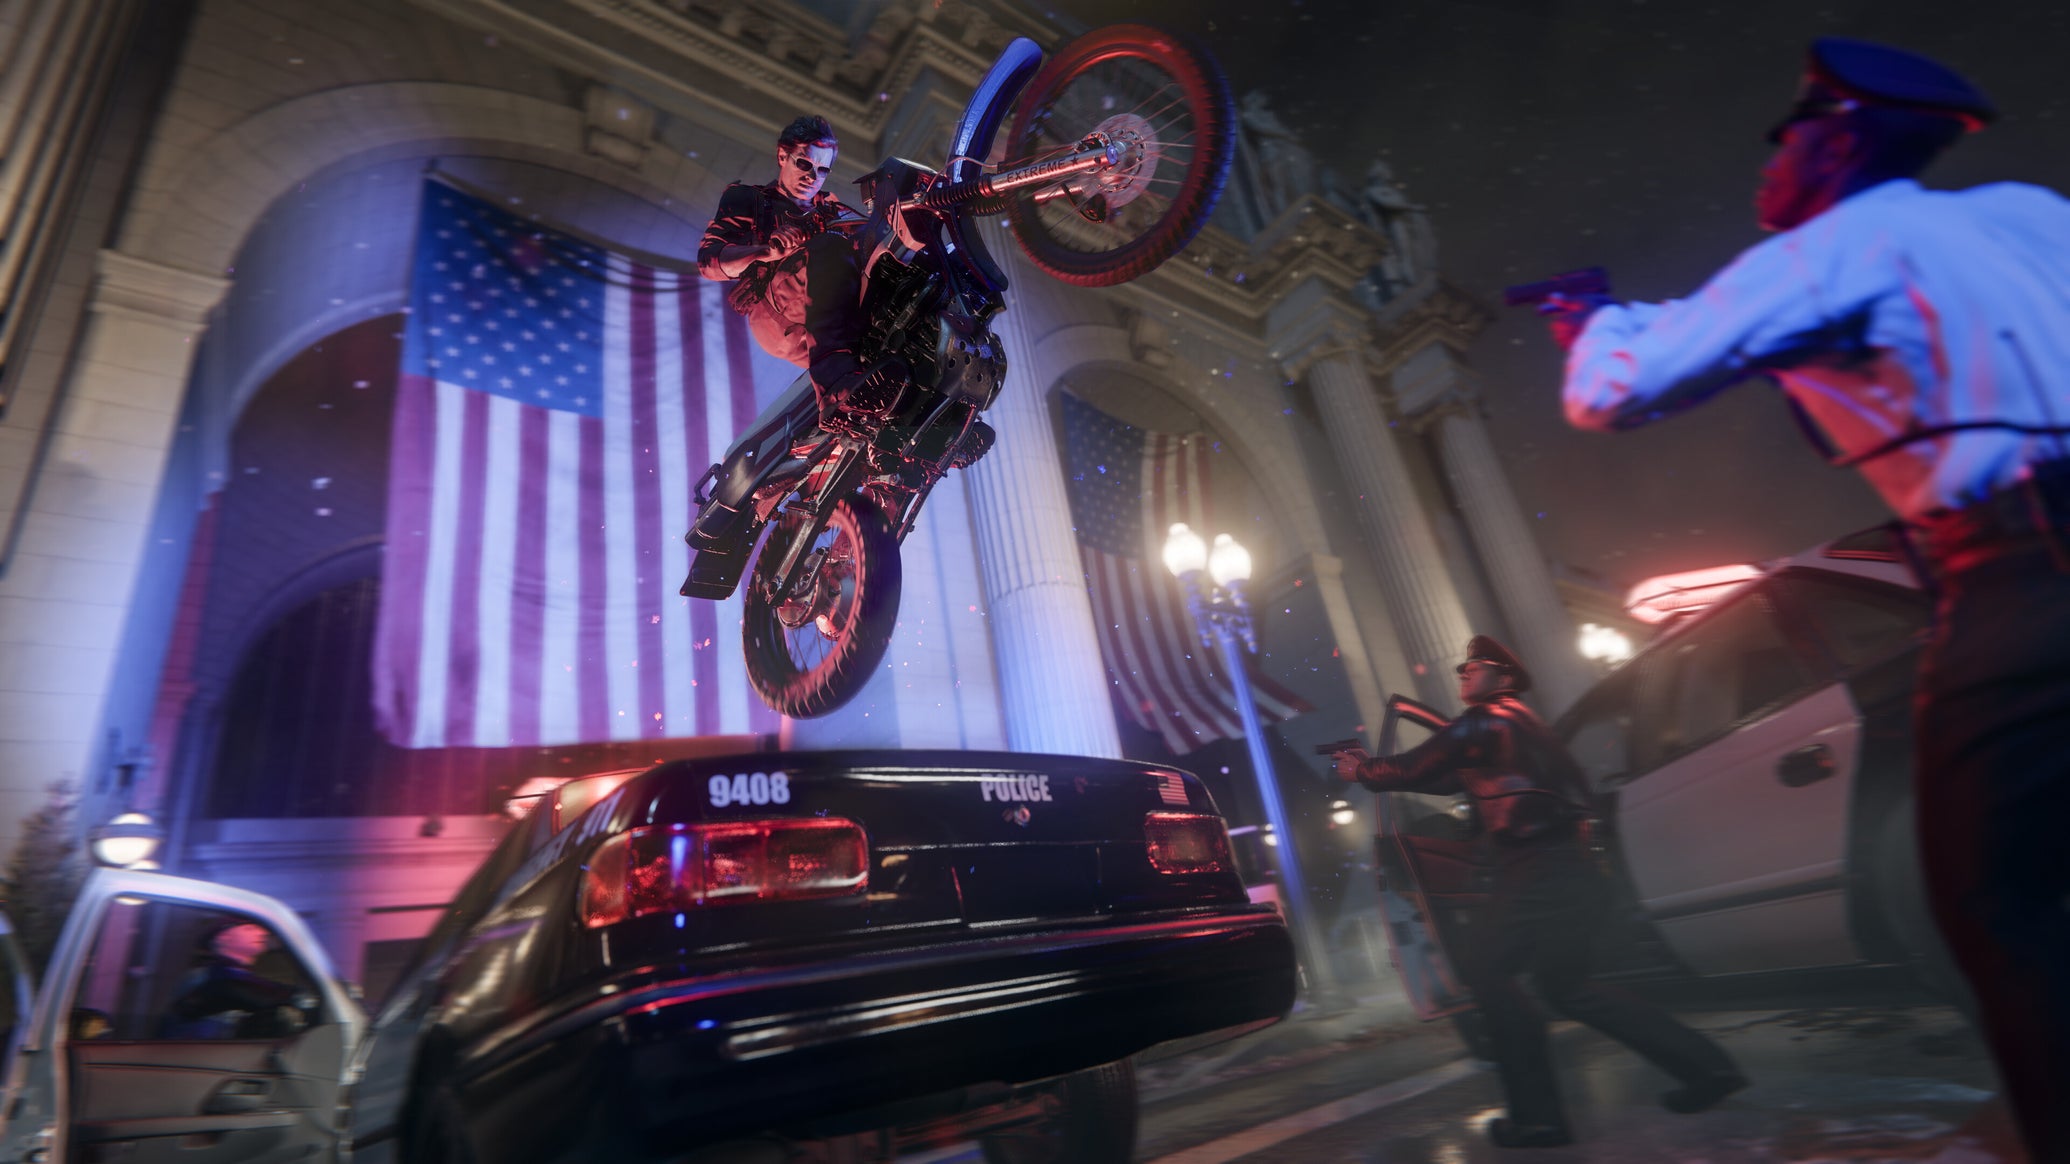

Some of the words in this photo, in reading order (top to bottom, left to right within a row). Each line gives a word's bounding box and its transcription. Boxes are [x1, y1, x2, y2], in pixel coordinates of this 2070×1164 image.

[1007, 159, 1065, 183] EXTREME
[708, 772, 790, 807] 9408
[981, 774, 1053, 802] POLICE
